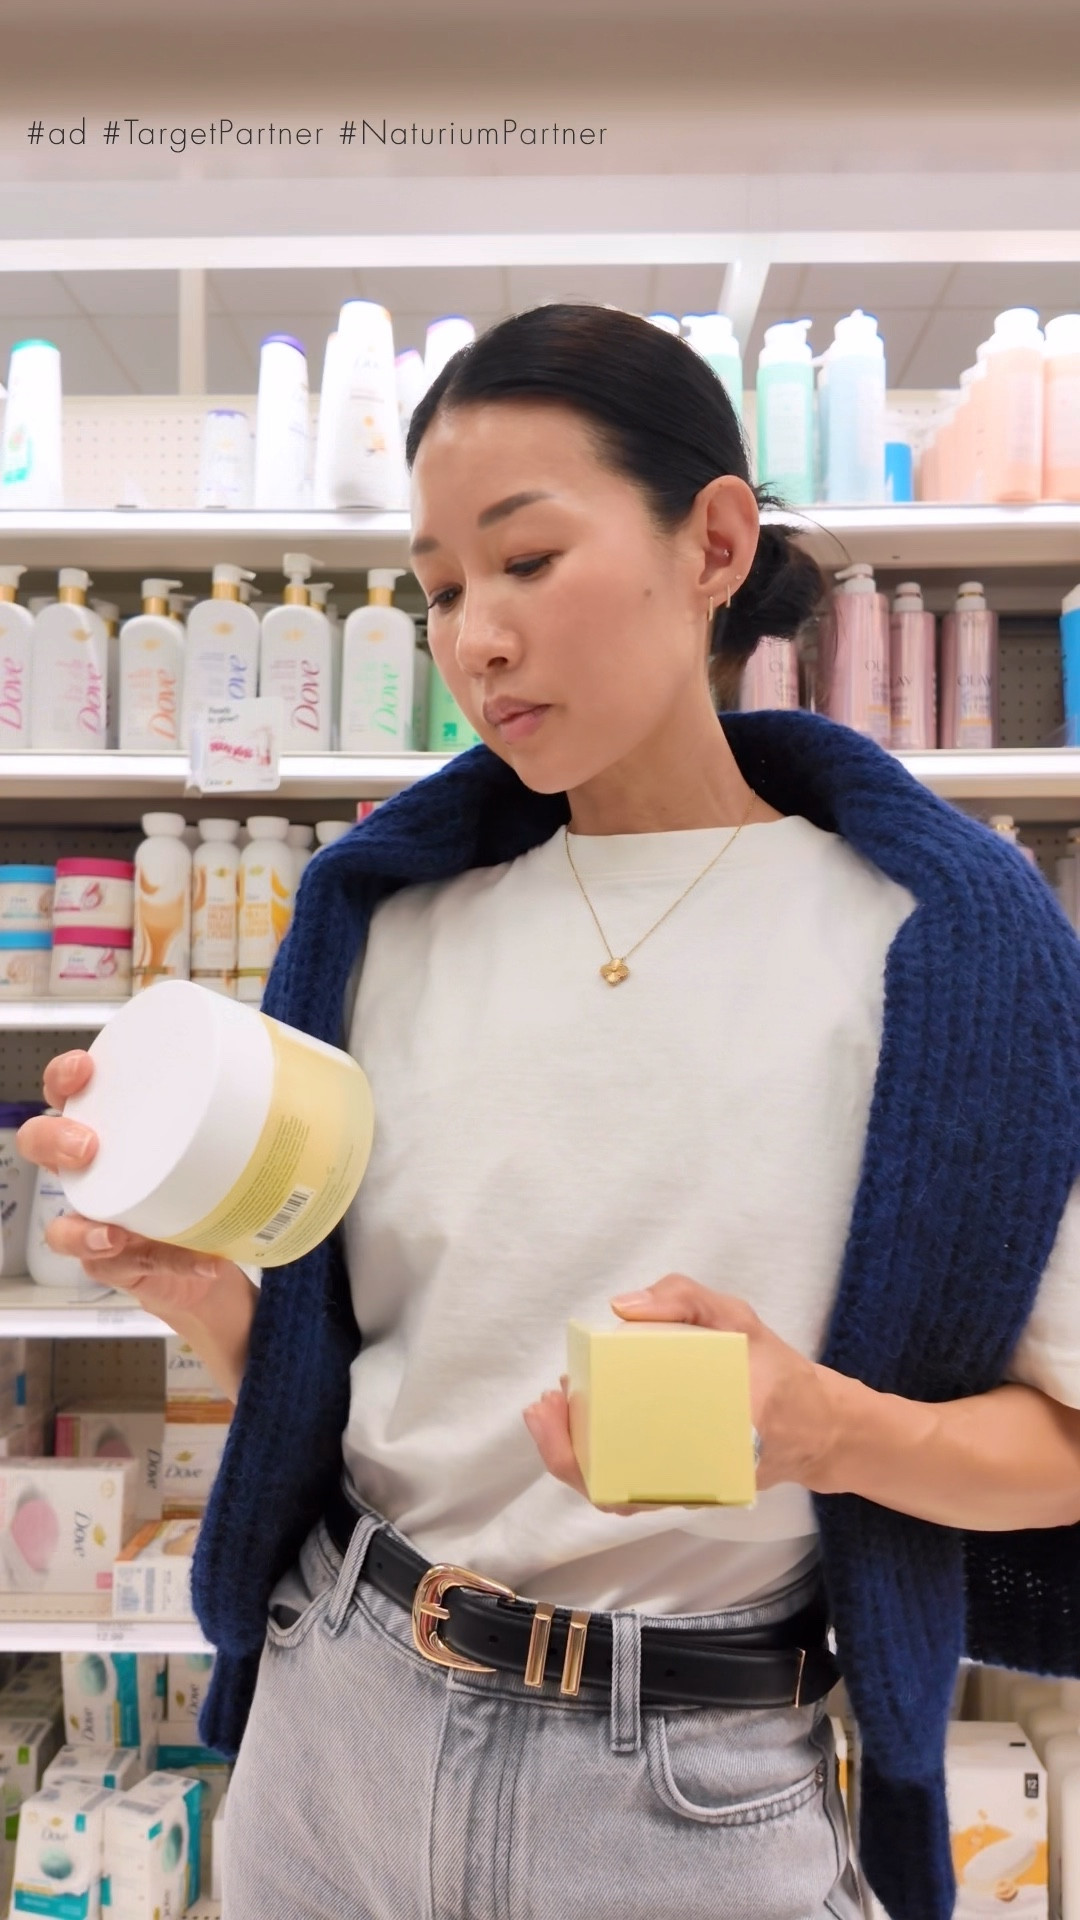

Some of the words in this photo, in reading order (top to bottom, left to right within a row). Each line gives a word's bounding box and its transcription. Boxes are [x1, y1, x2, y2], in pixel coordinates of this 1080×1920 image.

[78, 663, 102, 733] Dove
[228, 655, 247, 699] ove
[292, 660, 320, 731] Dove
[373, 663, 399, 735] Dove
[148, 669, 176, 740] Dove
[147, 1448, 161, 1489] Dove
[165, 1464, 202, 1478] Dove
[74, 1511, 92, 1558] Dove
[82, 1706, 96, 1742] Dove
[1026, 1780, 1038, 1790] 12
